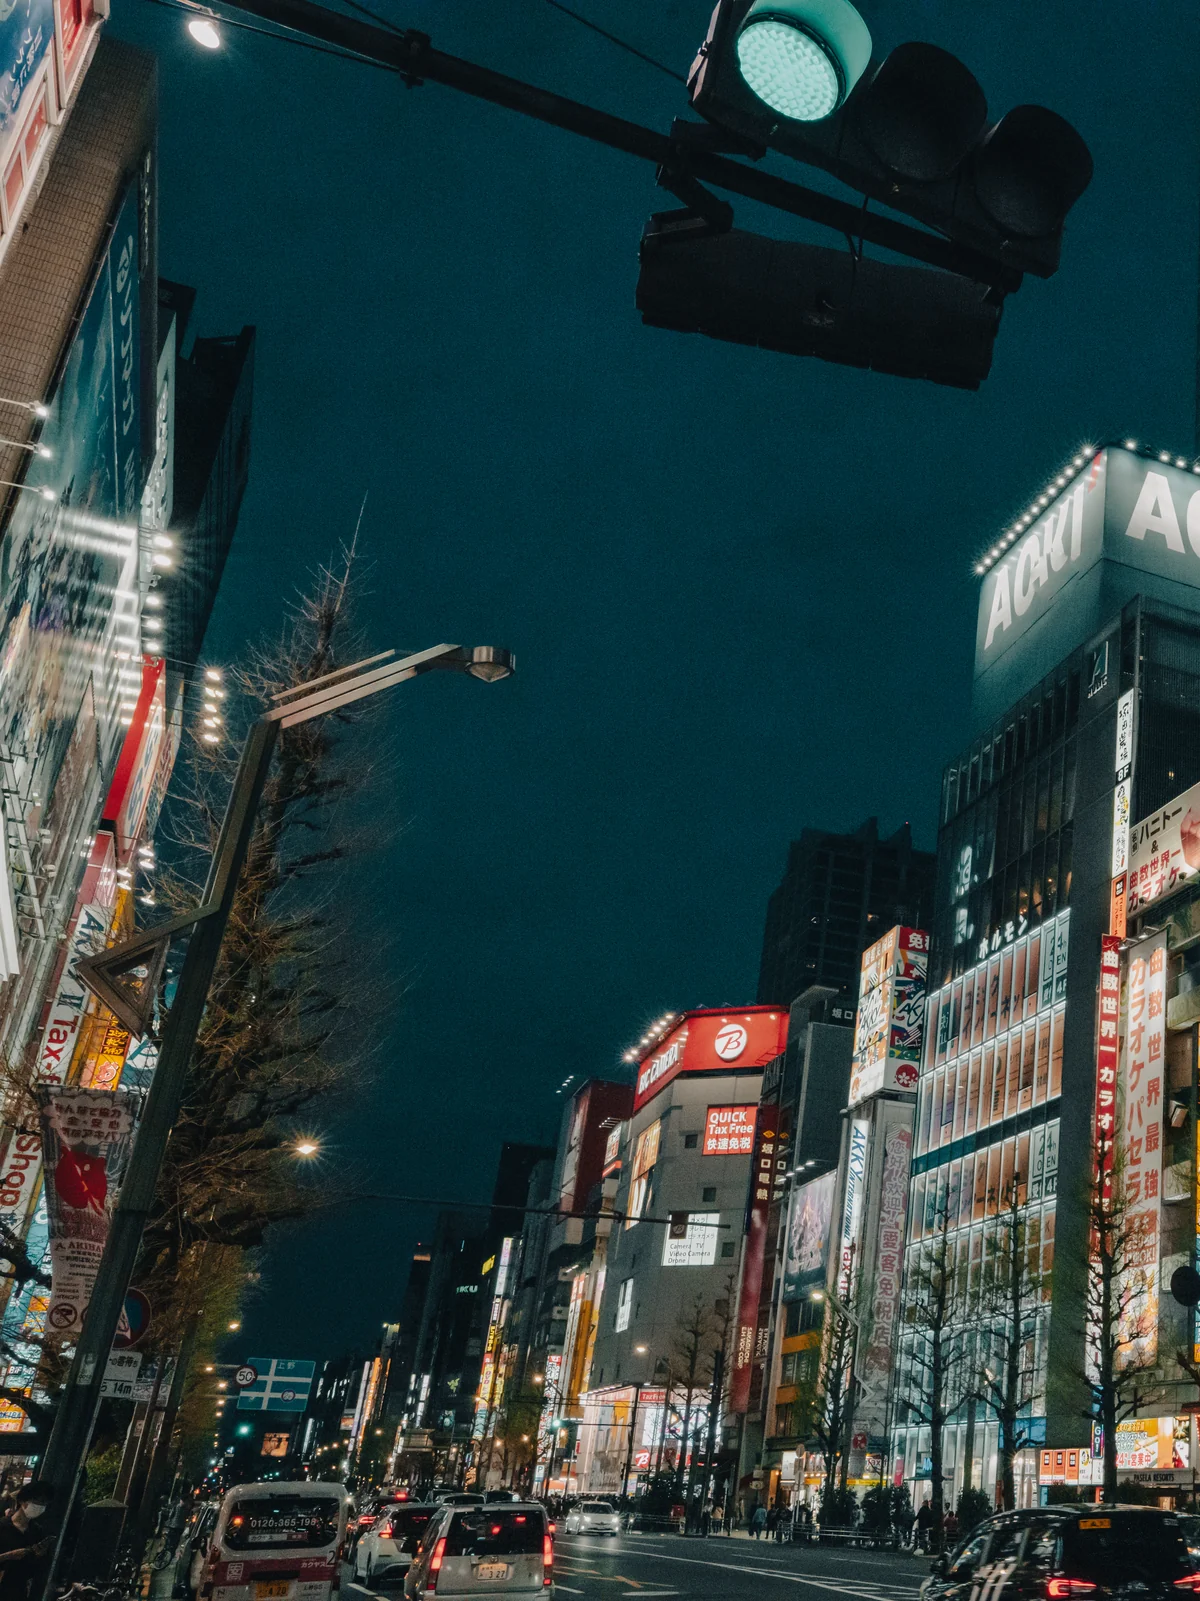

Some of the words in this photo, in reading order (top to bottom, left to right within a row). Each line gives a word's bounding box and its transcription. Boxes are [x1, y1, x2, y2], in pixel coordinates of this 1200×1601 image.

[984, 482, 1086, 650] AOKI
[1117, 765, 1130, 781] 8F
[1139, 807, 1183, 845] ハニトー
[1150, 842, 1159, 855] &
[1128, 867, 1181, 914] カラオケ
[909, 932, 929, 950] 免
[1100, 951, 1119, 1054] 曲数世界一
[710, 1111, 748, 1123] QUICK
[708, 1124, 728, 1135] Tax
[729, 1123, 754, 1134] Free
[707, 1137, 751, 1151] 快速免税
[853, 1126, 866, 1183] AKKY
[1036, 1155, 1056, 1172] OEN
[239, 1370, 253, 1382] 50
[113, 1382, 132, 1395] 14m
[1153, 1473, 1174, 1481] RESORTS
